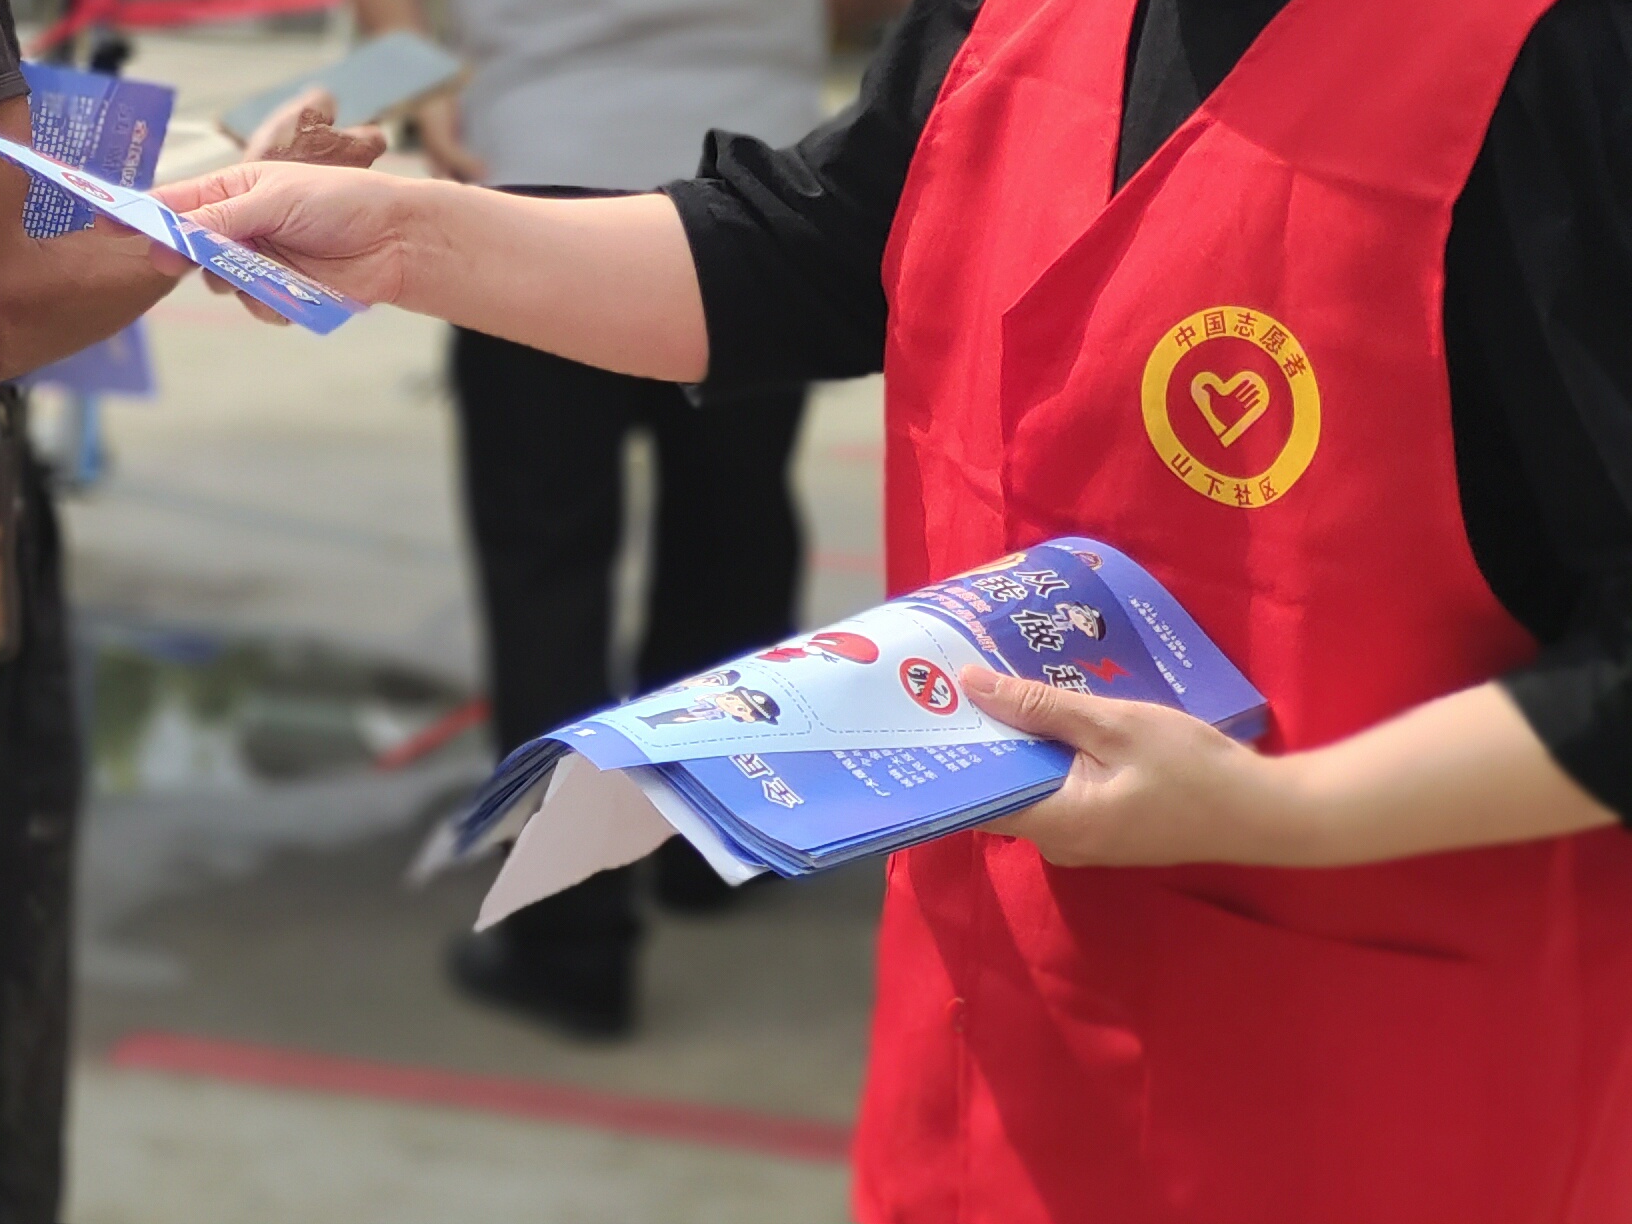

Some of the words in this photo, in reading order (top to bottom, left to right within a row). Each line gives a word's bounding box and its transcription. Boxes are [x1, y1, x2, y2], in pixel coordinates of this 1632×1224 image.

[1174, 311, 1306, 378] 中国志愿者
[1171, 452, 1278, 506] 山下社区
[728, 754, 805, 808] 全民
